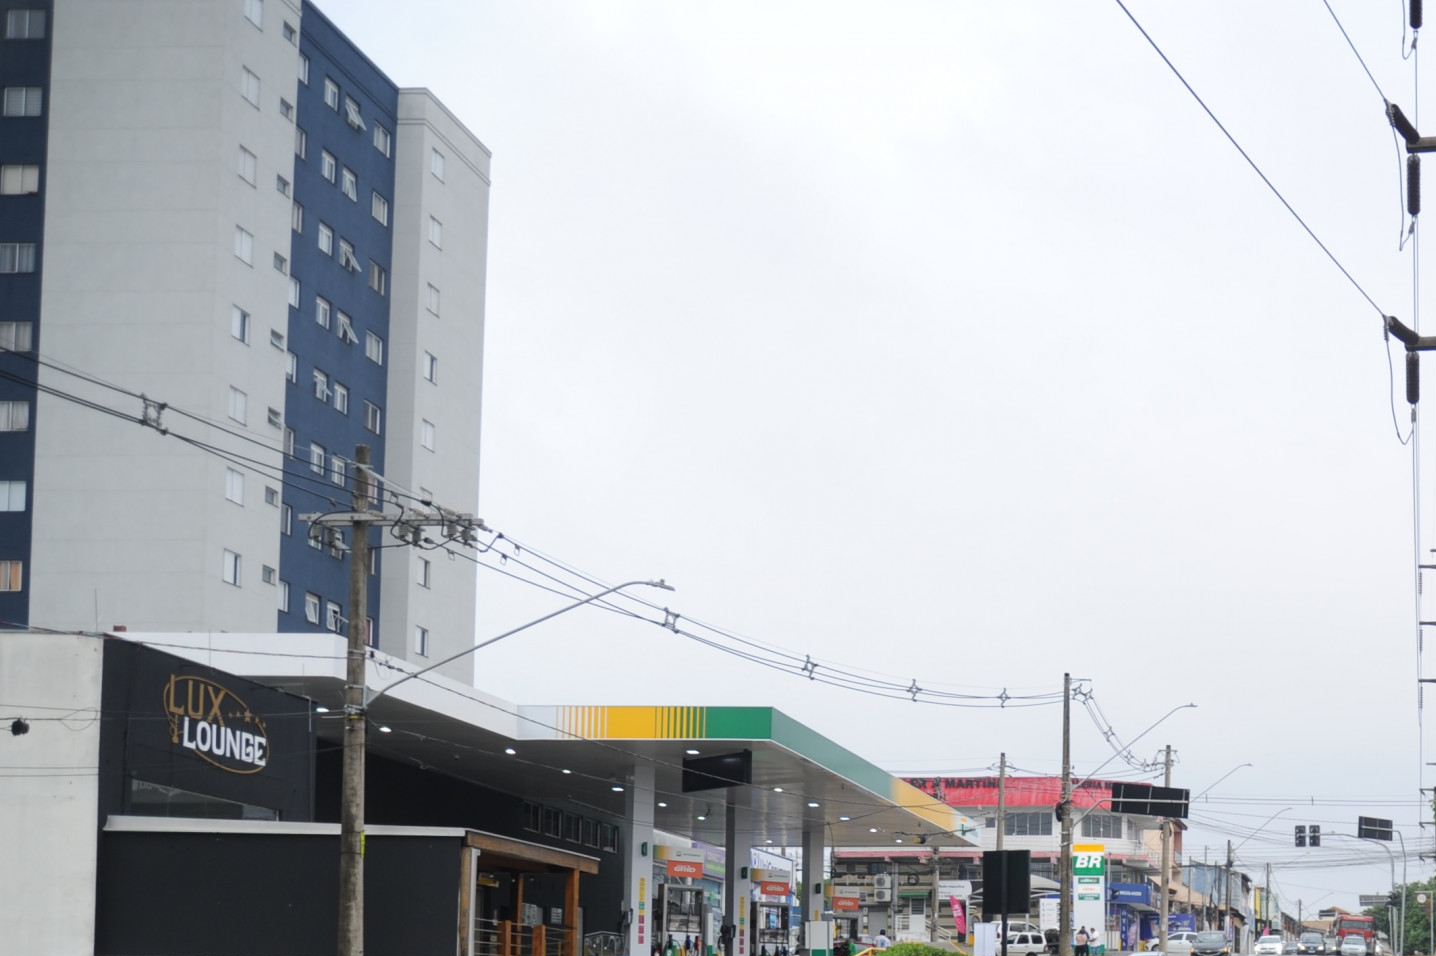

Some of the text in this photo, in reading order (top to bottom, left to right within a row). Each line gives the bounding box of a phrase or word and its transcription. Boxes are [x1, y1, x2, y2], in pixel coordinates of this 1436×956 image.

[169, 674, 226, 728] LUX
[183, 716, 266, 767] LOUNGE
[1075, 855, 1102, 868] BR
